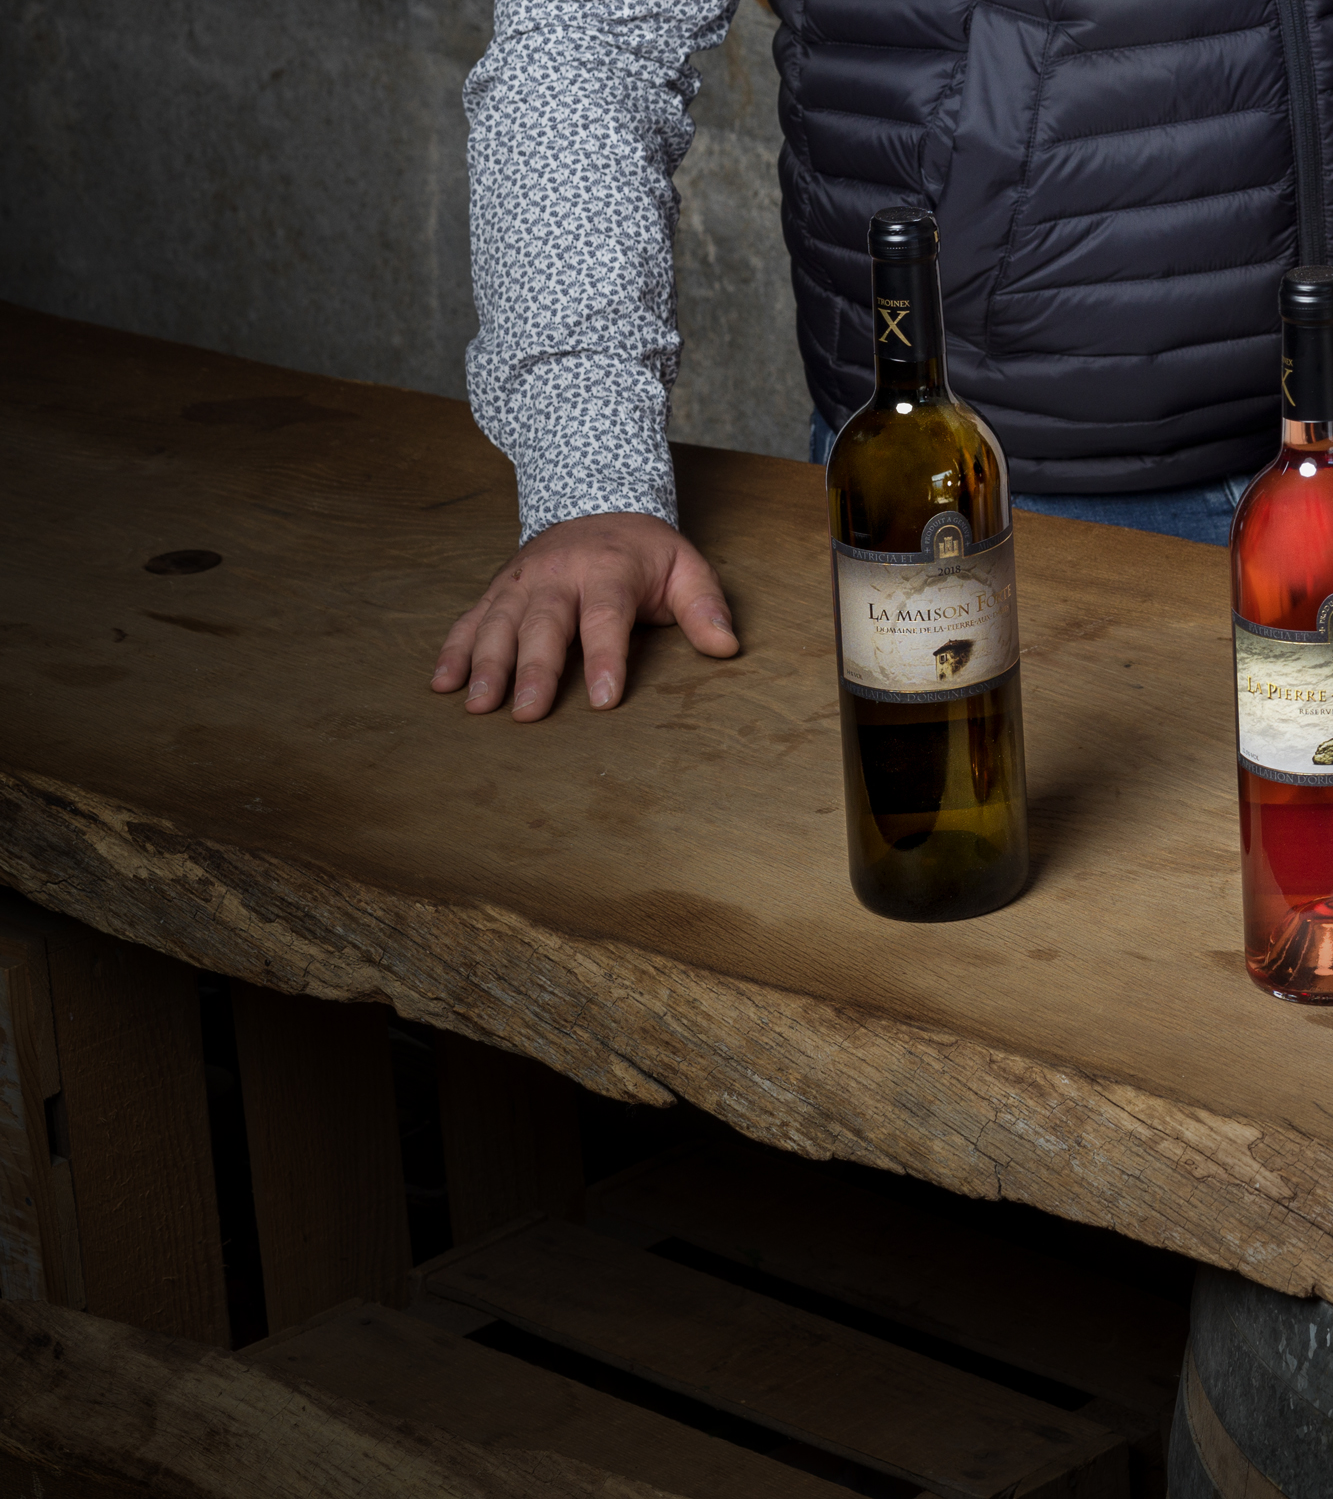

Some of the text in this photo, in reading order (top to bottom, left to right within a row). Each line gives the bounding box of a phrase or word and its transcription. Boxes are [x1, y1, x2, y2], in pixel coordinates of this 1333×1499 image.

[877, 297, 910, 307] TROINEX
[878, 308, 912, 347] X
[925, 518, 945, 544] PRODUIT
[852, 549, 915, 563] PATRICIA ET
[938, 565, 961, 577] 2018
[868, 603, 889, 622] LA
[896, 603, 970, 622] MAISON
[876, 625, 917, 635] DOMAINE
[1249, 624, 1309, 641] PATRICIA ET
[1247, 675, 1263, 695] LA
[906, 688, 965, 702] D'ORIGINE
